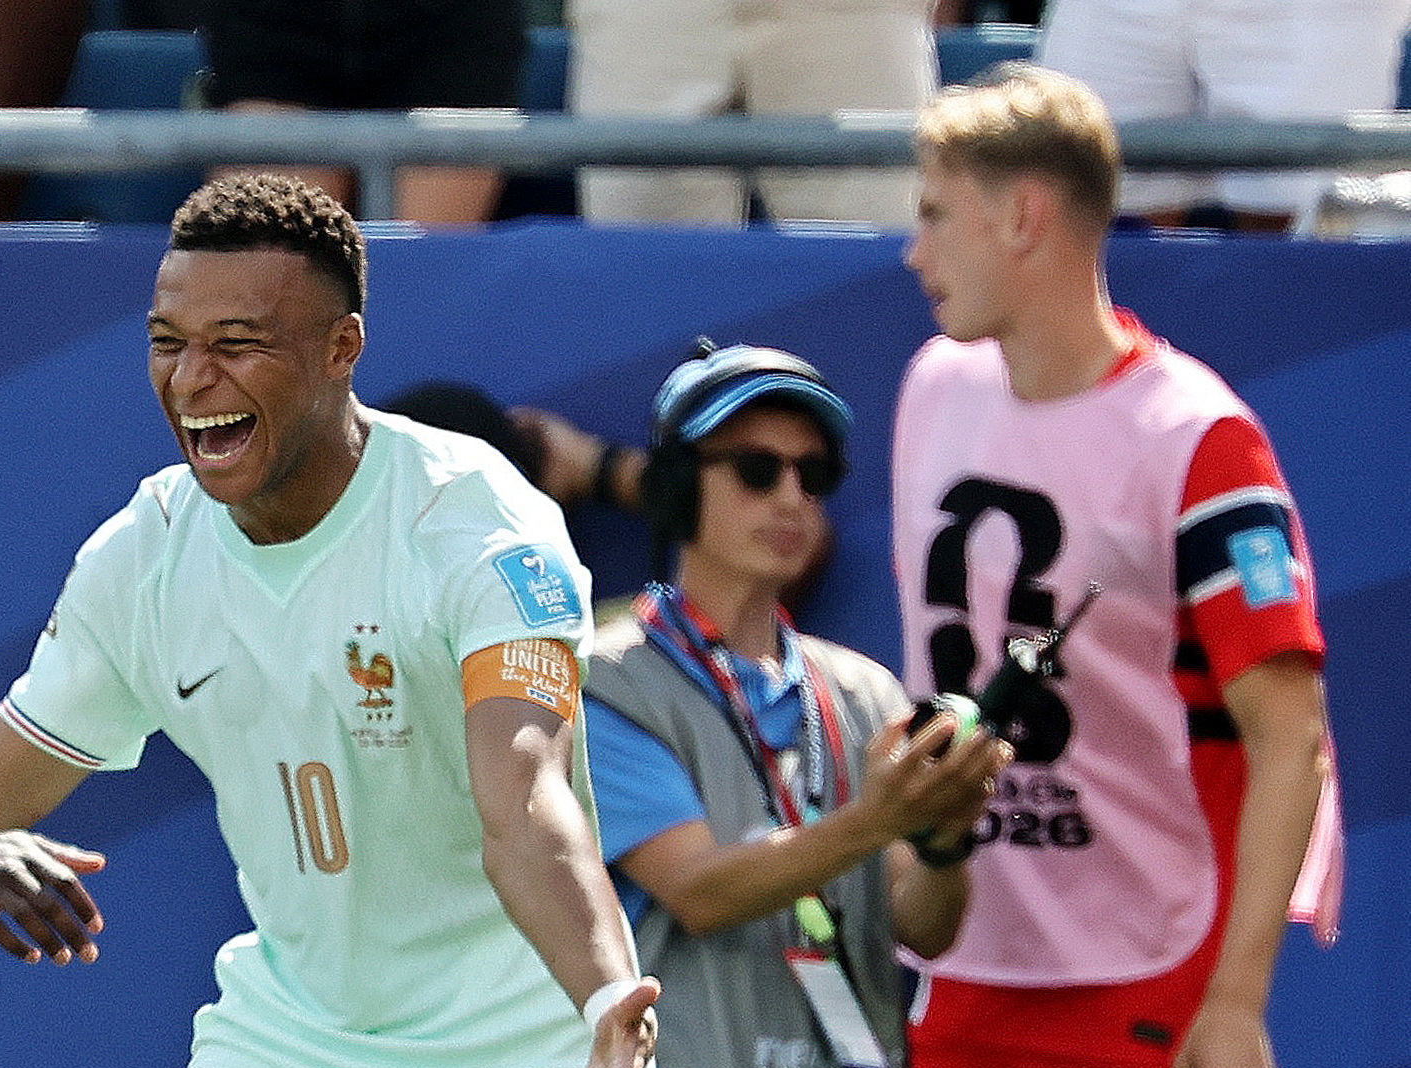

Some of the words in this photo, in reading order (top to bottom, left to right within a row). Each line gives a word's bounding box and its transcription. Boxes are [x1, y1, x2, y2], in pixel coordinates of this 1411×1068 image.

[502, 648, 571, 687] UNITES
[278, 761, 349, 875] 10
[972, 811, 1093, 848] 026
